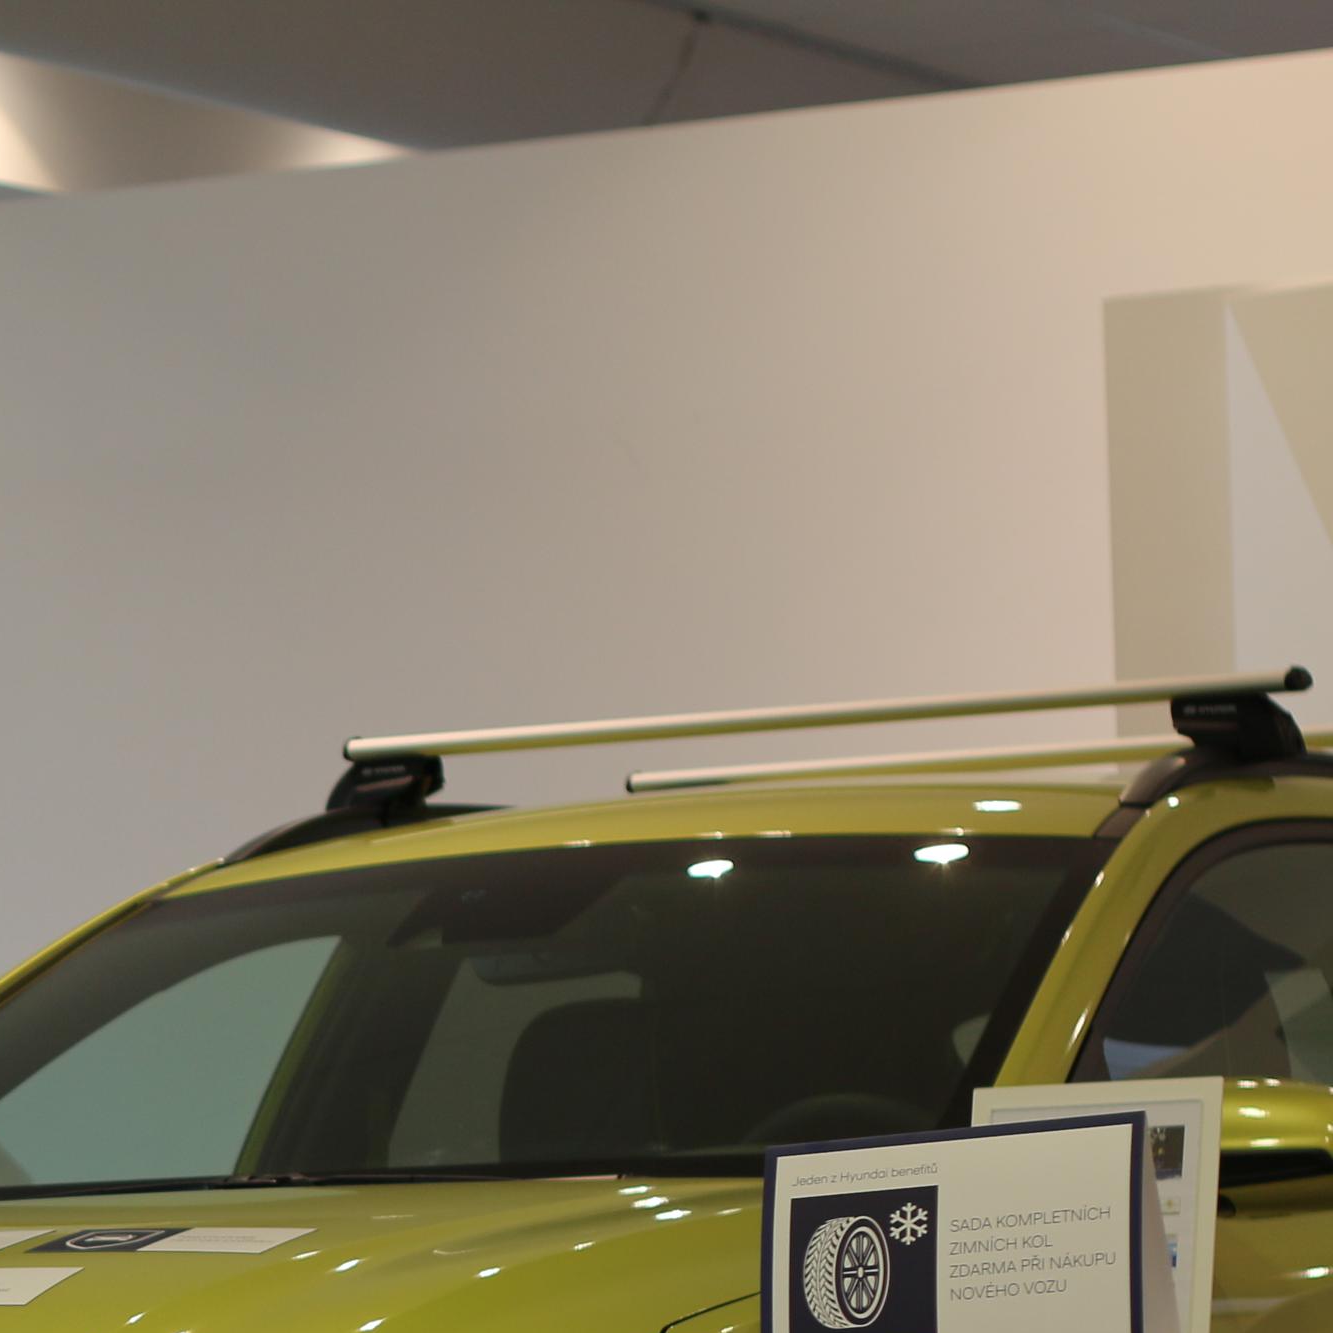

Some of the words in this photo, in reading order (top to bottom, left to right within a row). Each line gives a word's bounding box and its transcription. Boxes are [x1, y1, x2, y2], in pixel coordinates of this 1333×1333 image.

[791, 1174, 828, 1187] Jeden
[830, 1175, 838, 1183] z
[839, 1168, 889, 1184] Hyundai
[891, 1163, 939, 1178] benefitů
[949, 1216, 993, 1233] SADA
[996, 1204, 1112, 1229] KOMPLETNÍCH
[949, 1235, 1018, 1256] ZIMNÍCH
[1022, 1234, 1054, 1250] KOL
[949, 1260, 1017, 1279] ZDARMA
[1020, 1255, 1045, 1273] PŘI
[1049, 1251, 1117, 1270] NÁKUPU
[949, 1281, 1021, 1301] NOVÉHO
[1023, 1279, 1068, 1295] VOZU
